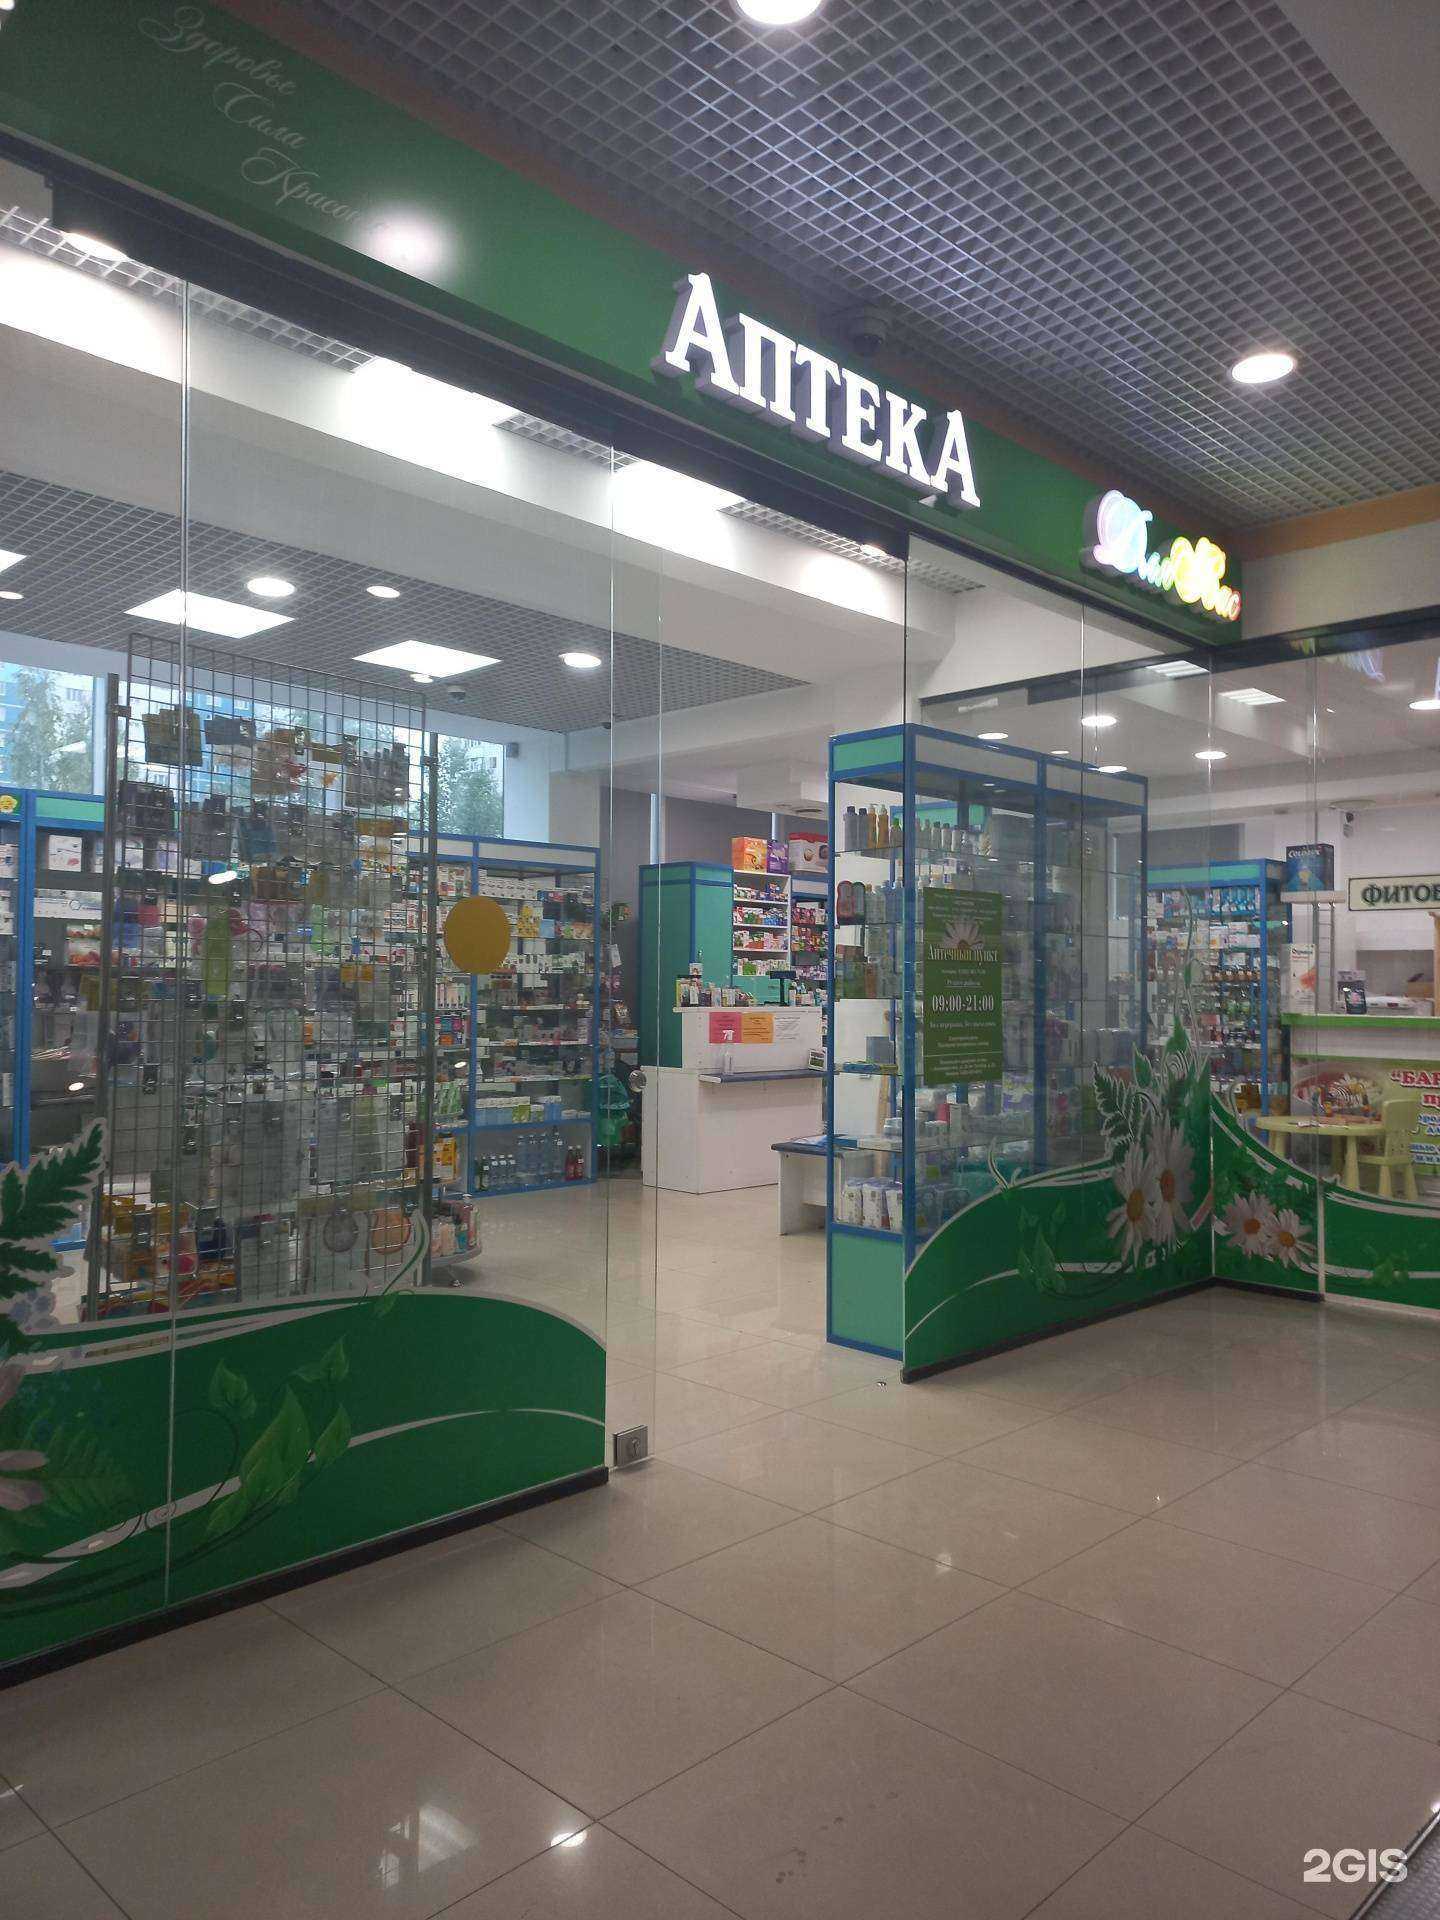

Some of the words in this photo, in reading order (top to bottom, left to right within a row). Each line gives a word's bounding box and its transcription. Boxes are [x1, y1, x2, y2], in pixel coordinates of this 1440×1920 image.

[212, 81, 307, 149] Сила
[665, 272, 980, 507] АПТЕКА
[932, 994, 994, 1012] 09:00-21:00
